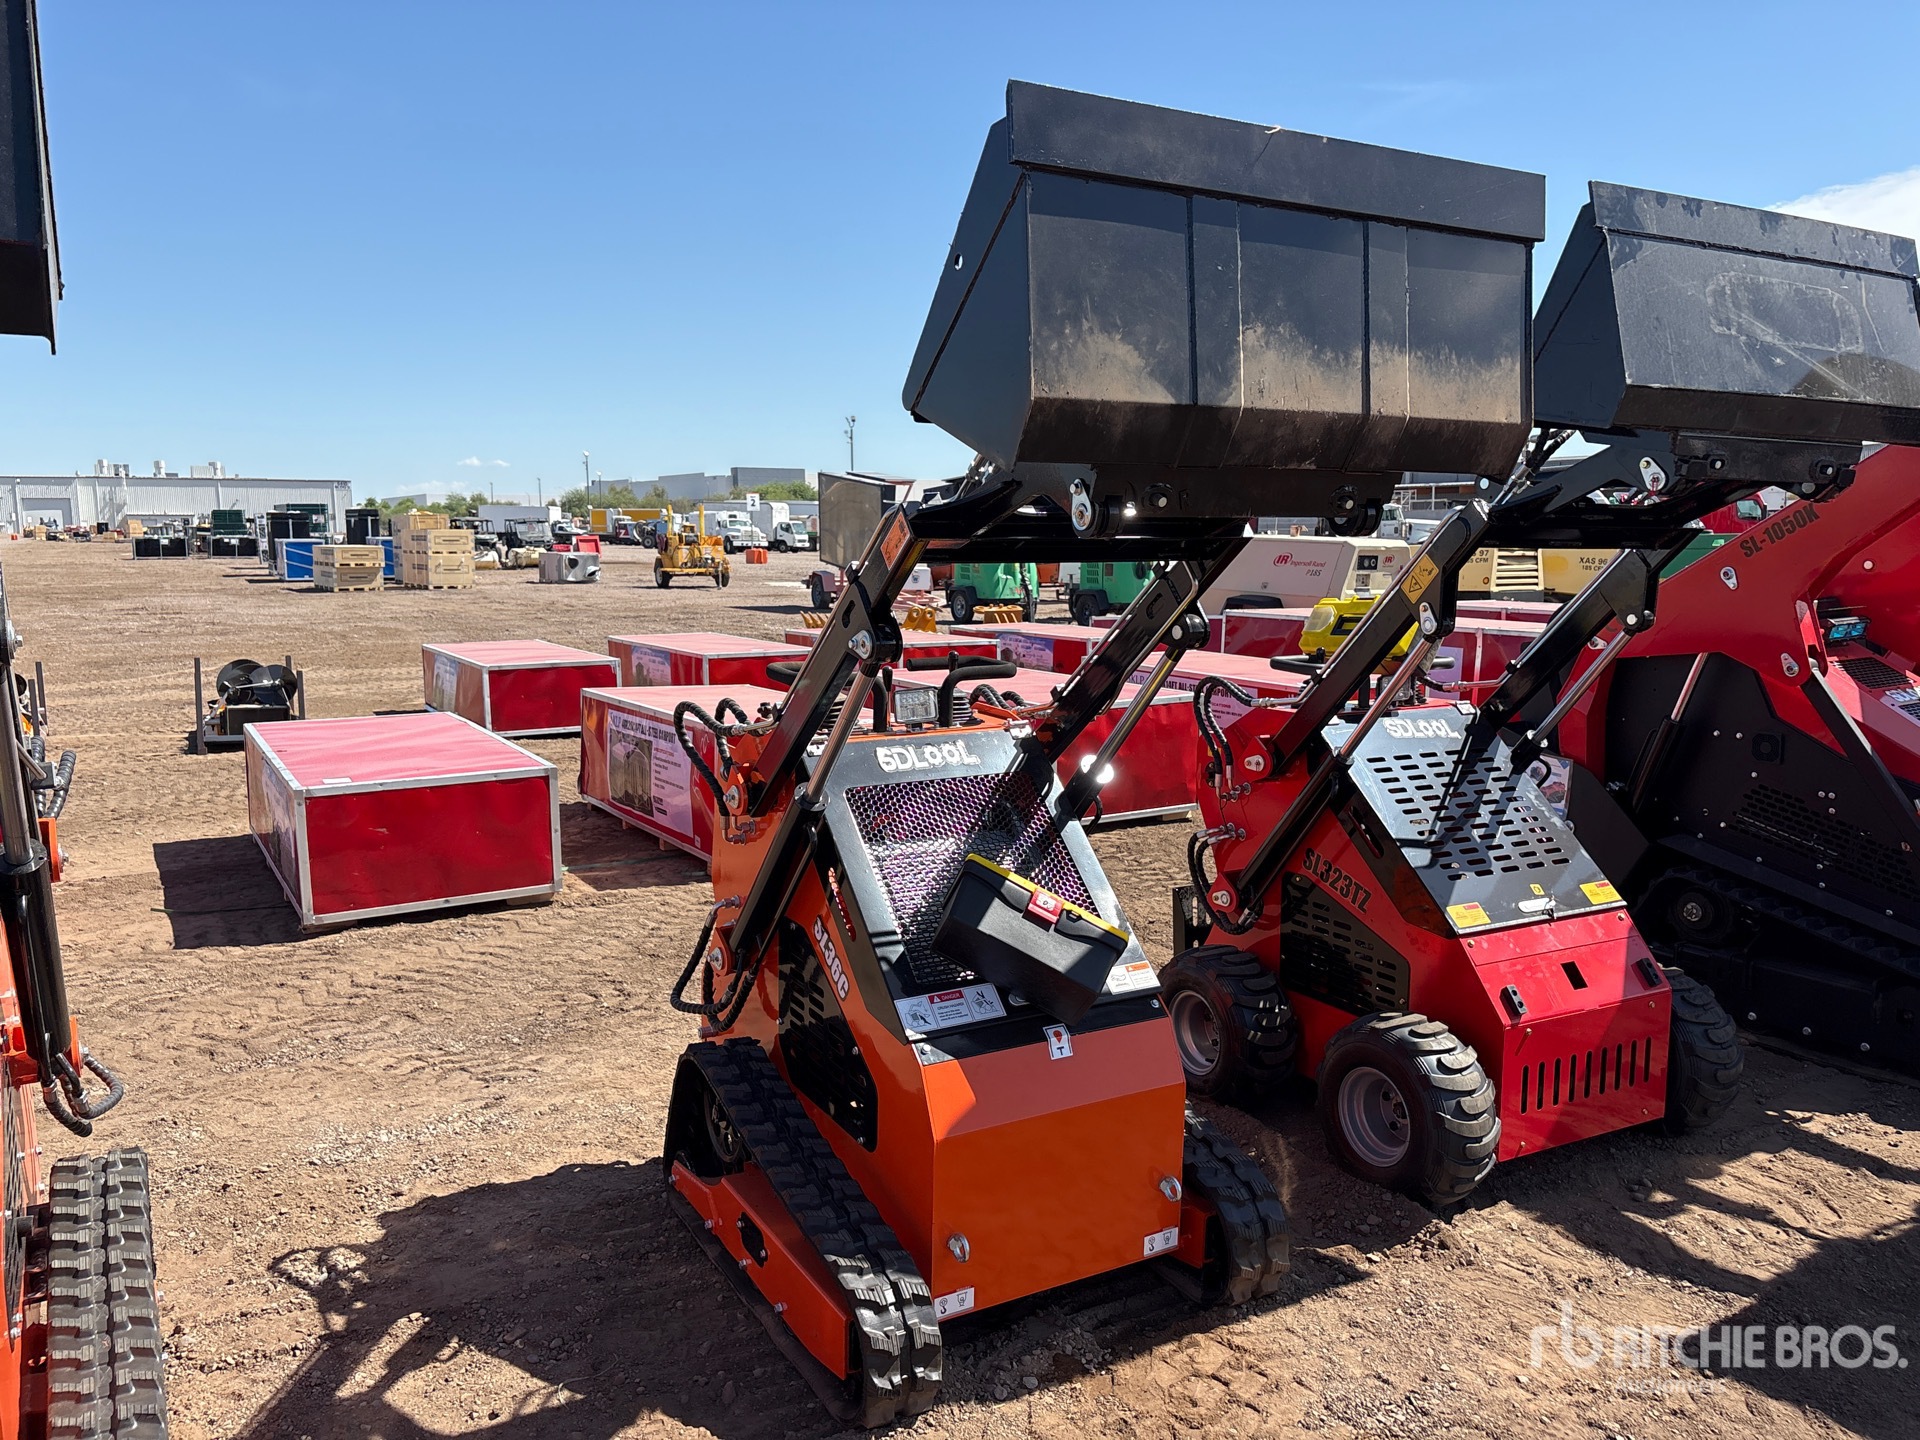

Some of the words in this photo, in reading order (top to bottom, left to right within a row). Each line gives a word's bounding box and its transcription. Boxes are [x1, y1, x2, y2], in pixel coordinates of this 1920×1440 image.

[750, 498, 756, 507] 2
[1739, 502, 1820, 558] SL-1050K
[1479, 549, 1490, 557] 97
[1274, 553, 1292, 566] IR
[1383, 555, 1394, 564] IR
[1579, 556, 1597, 565] XAS
[1598, 558, 1609, 566] 96
[1305, 569, 1323, 577] P185
[1302, 847, 1372, 915] SL323TZ
[814, 914, 850, 1002] SL36C
[941, 993, 961, 1001] DANGER
[1056, 1046, 1065, 1056] T
